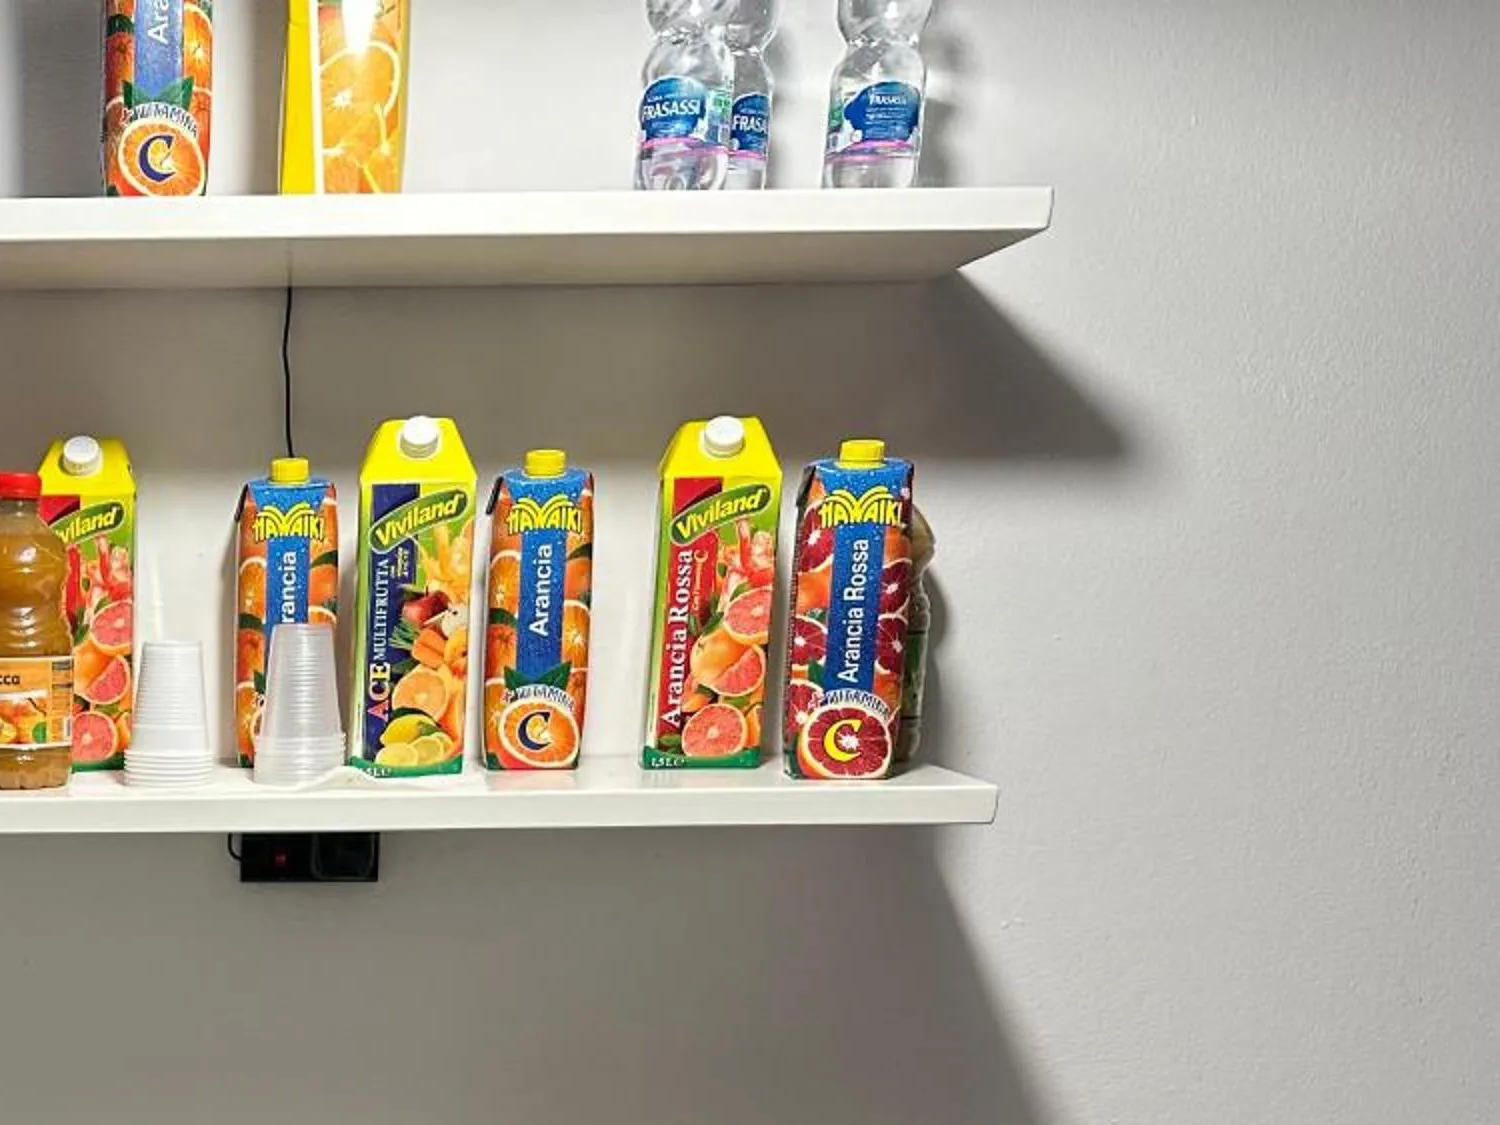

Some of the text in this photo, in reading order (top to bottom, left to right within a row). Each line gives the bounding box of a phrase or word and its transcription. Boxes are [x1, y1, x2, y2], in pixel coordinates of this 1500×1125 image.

[643, 100, 701, 120] FRASASSI
[137, 133, 177, 183] C
[374, 495, 461, 546] Viviland
[675, 488, 763, 540] Viviland
[279, 550, 298, 624] rancia
[529, 543, 554, 637] Arancia
[837, 538, 870, 684] Arancia Rossa
[660, 548, 694, 729] Arancia Rossa
[367, 662, 391, 722] ACE
[517, 711, 552, 751] C
[823, 718, 863, 763] C
